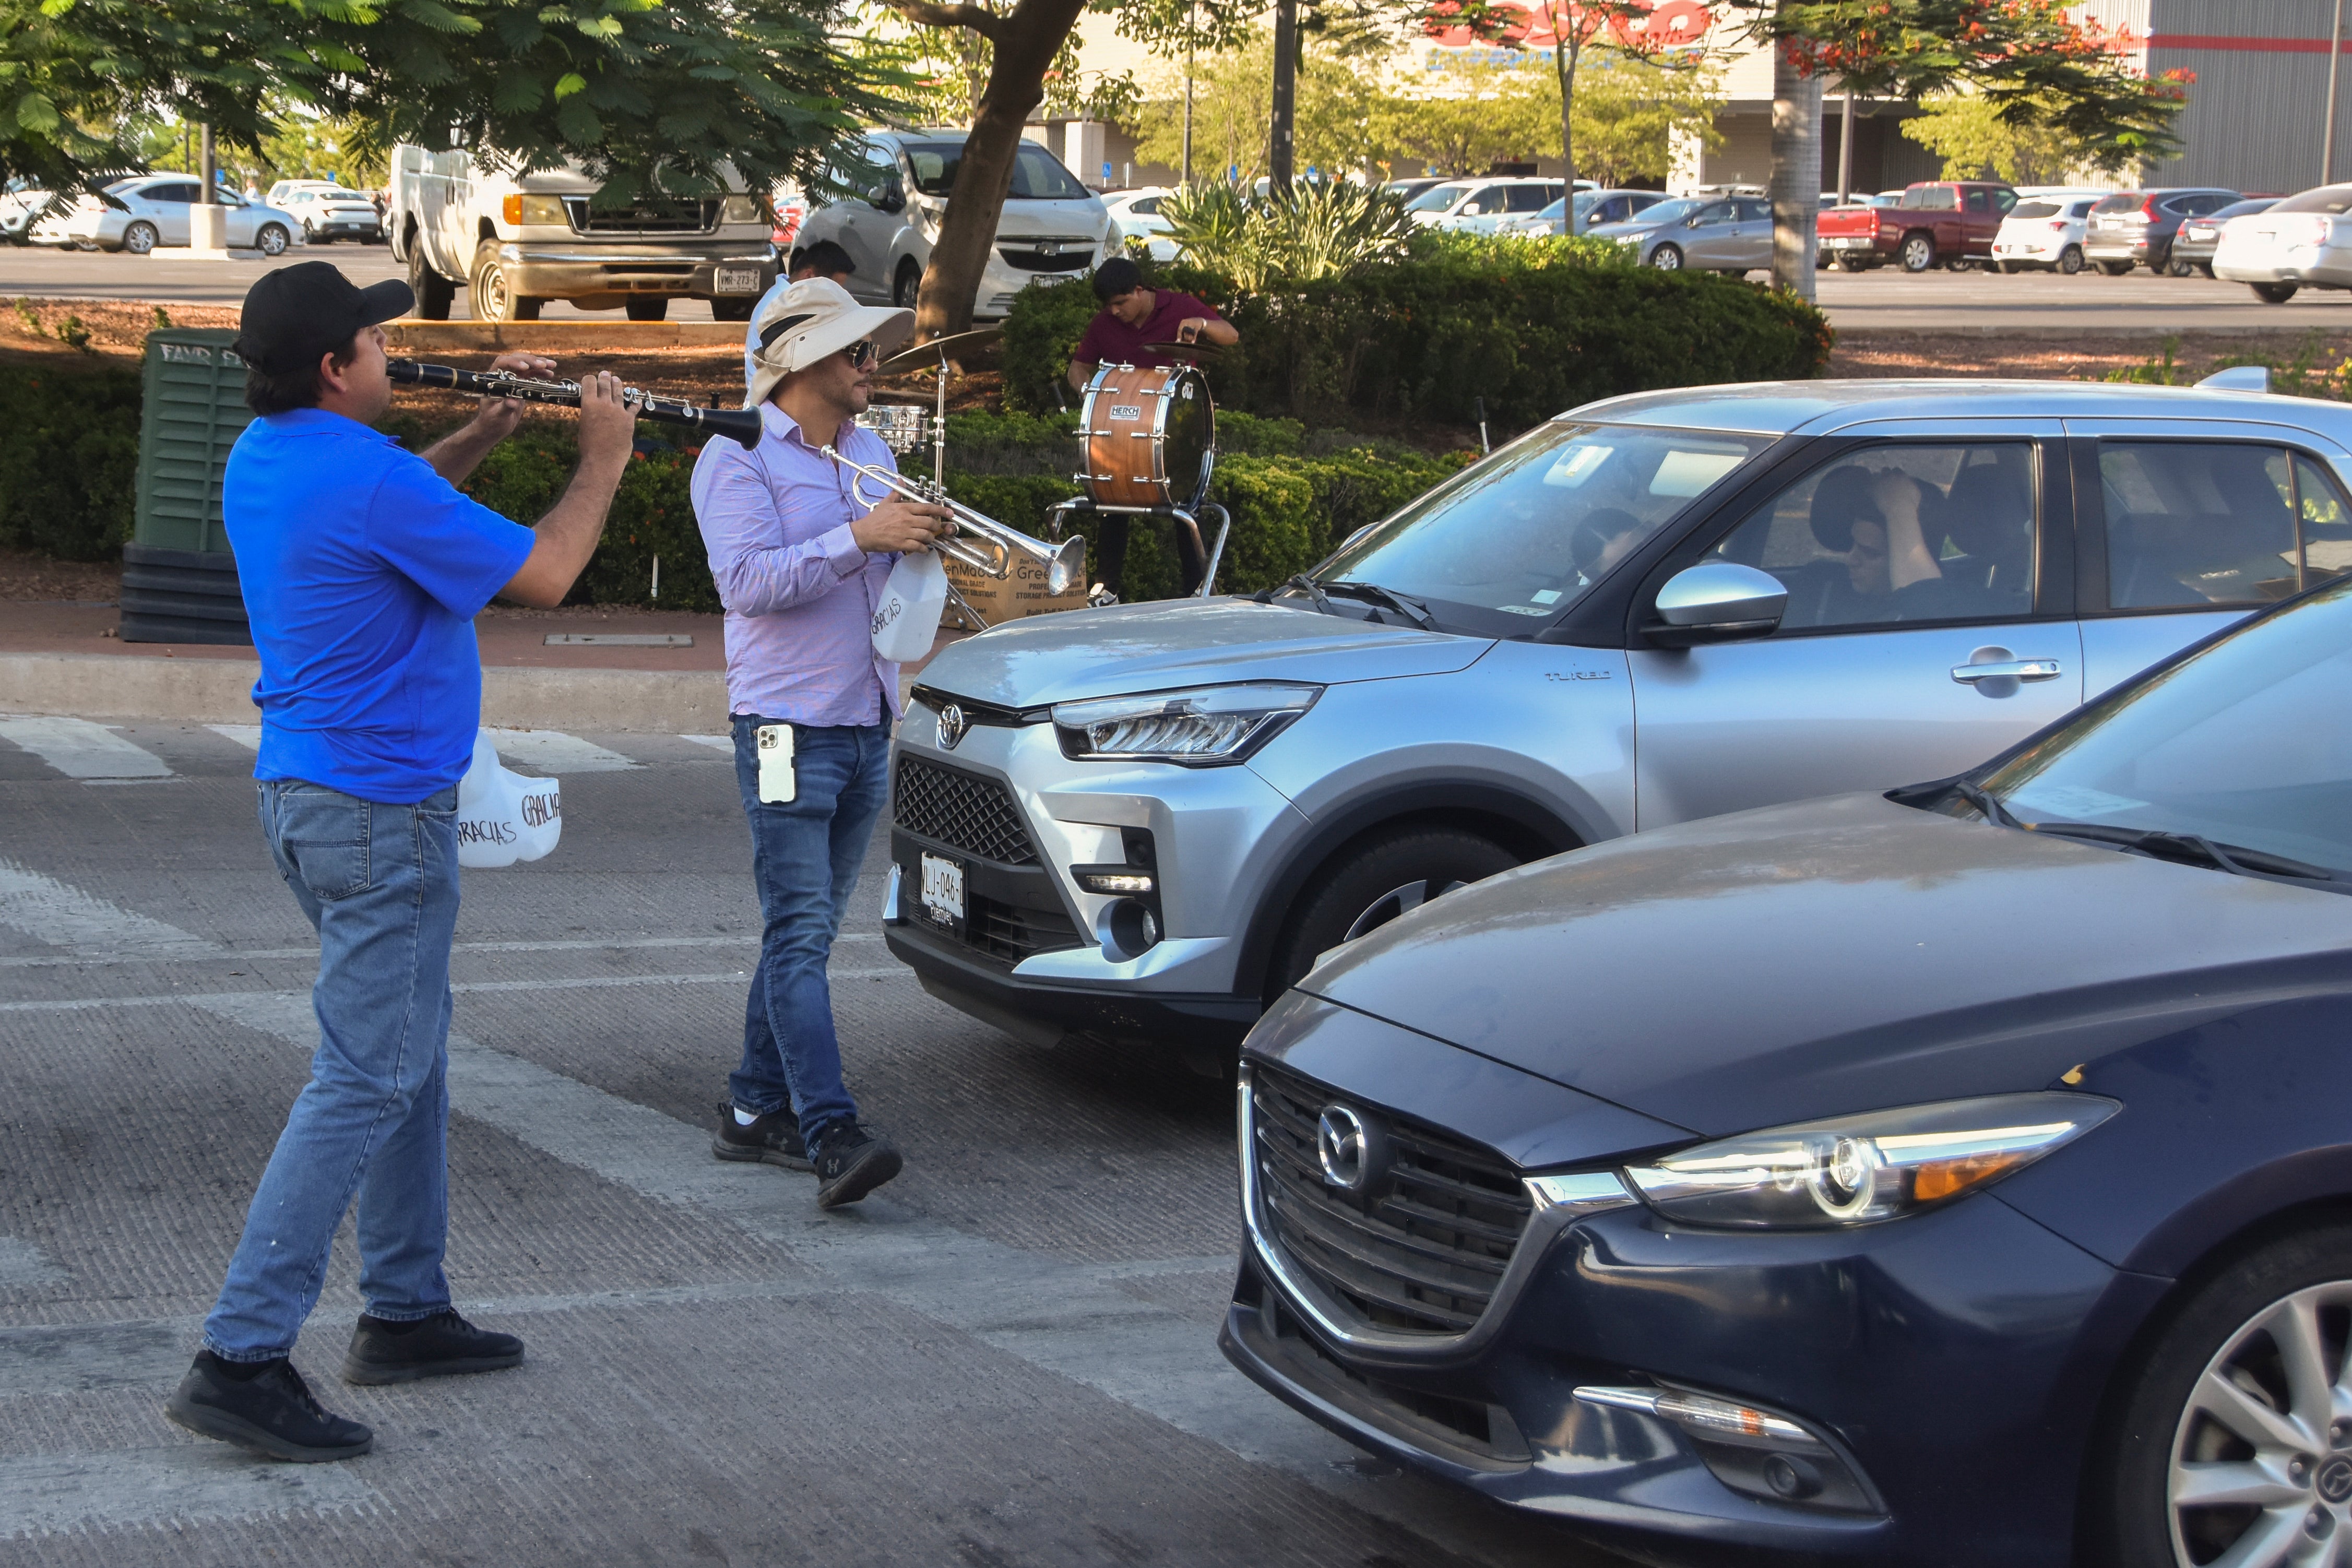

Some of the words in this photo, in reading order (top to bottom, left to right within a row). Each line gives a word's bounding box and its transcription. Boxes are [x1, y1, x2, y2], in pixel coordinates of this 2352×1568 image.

[1112, 407, 1139, 416] HERCH
[970, 589, 997, 598] SOLUTIONS
[871, 598, 901, 635] GRACIAS
[1545, 671, 1612, 681] TURBO
[930, 900, 953, 926] Premier
